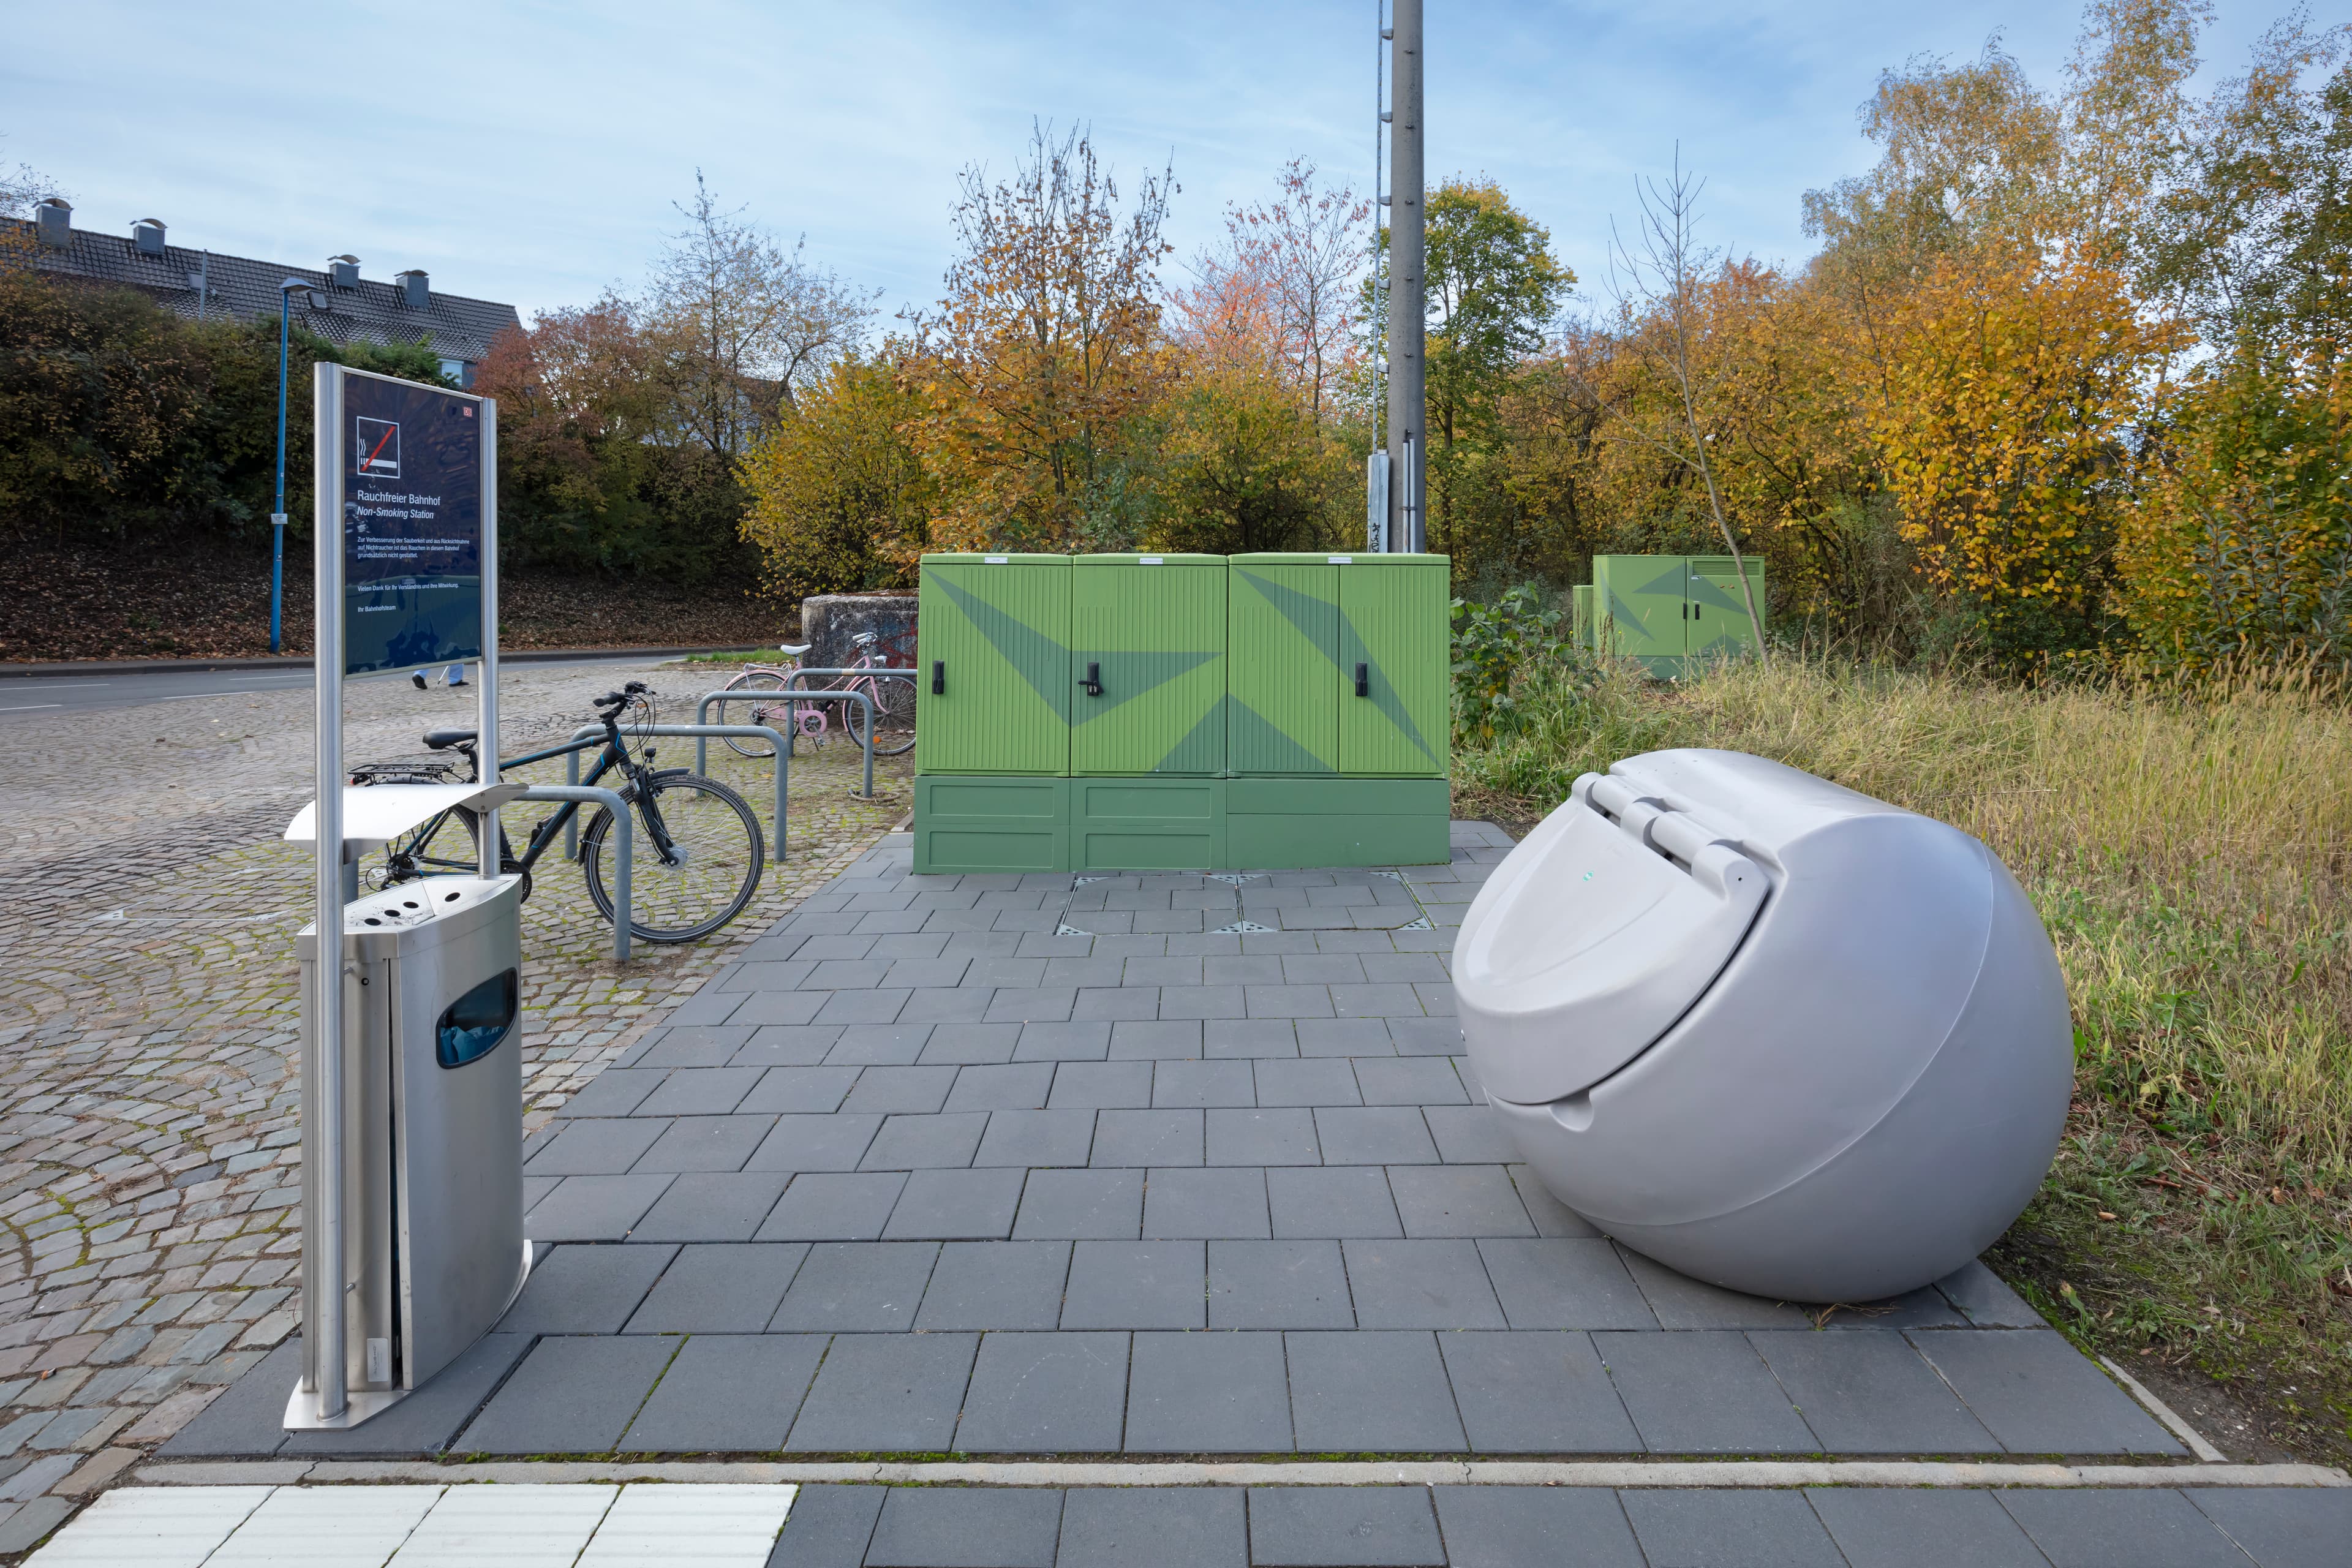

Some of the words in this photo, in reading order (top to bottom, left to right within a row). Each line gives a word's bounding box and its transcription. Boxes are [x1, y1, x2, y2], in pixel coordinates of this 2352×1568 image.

[358, 490, 407, 503] Rauchfreier
[409, 494, 441, 505] Bahnhof
[357, 506, 408, 519] Non-Smoking
[410, 509, 434, 519] Station
